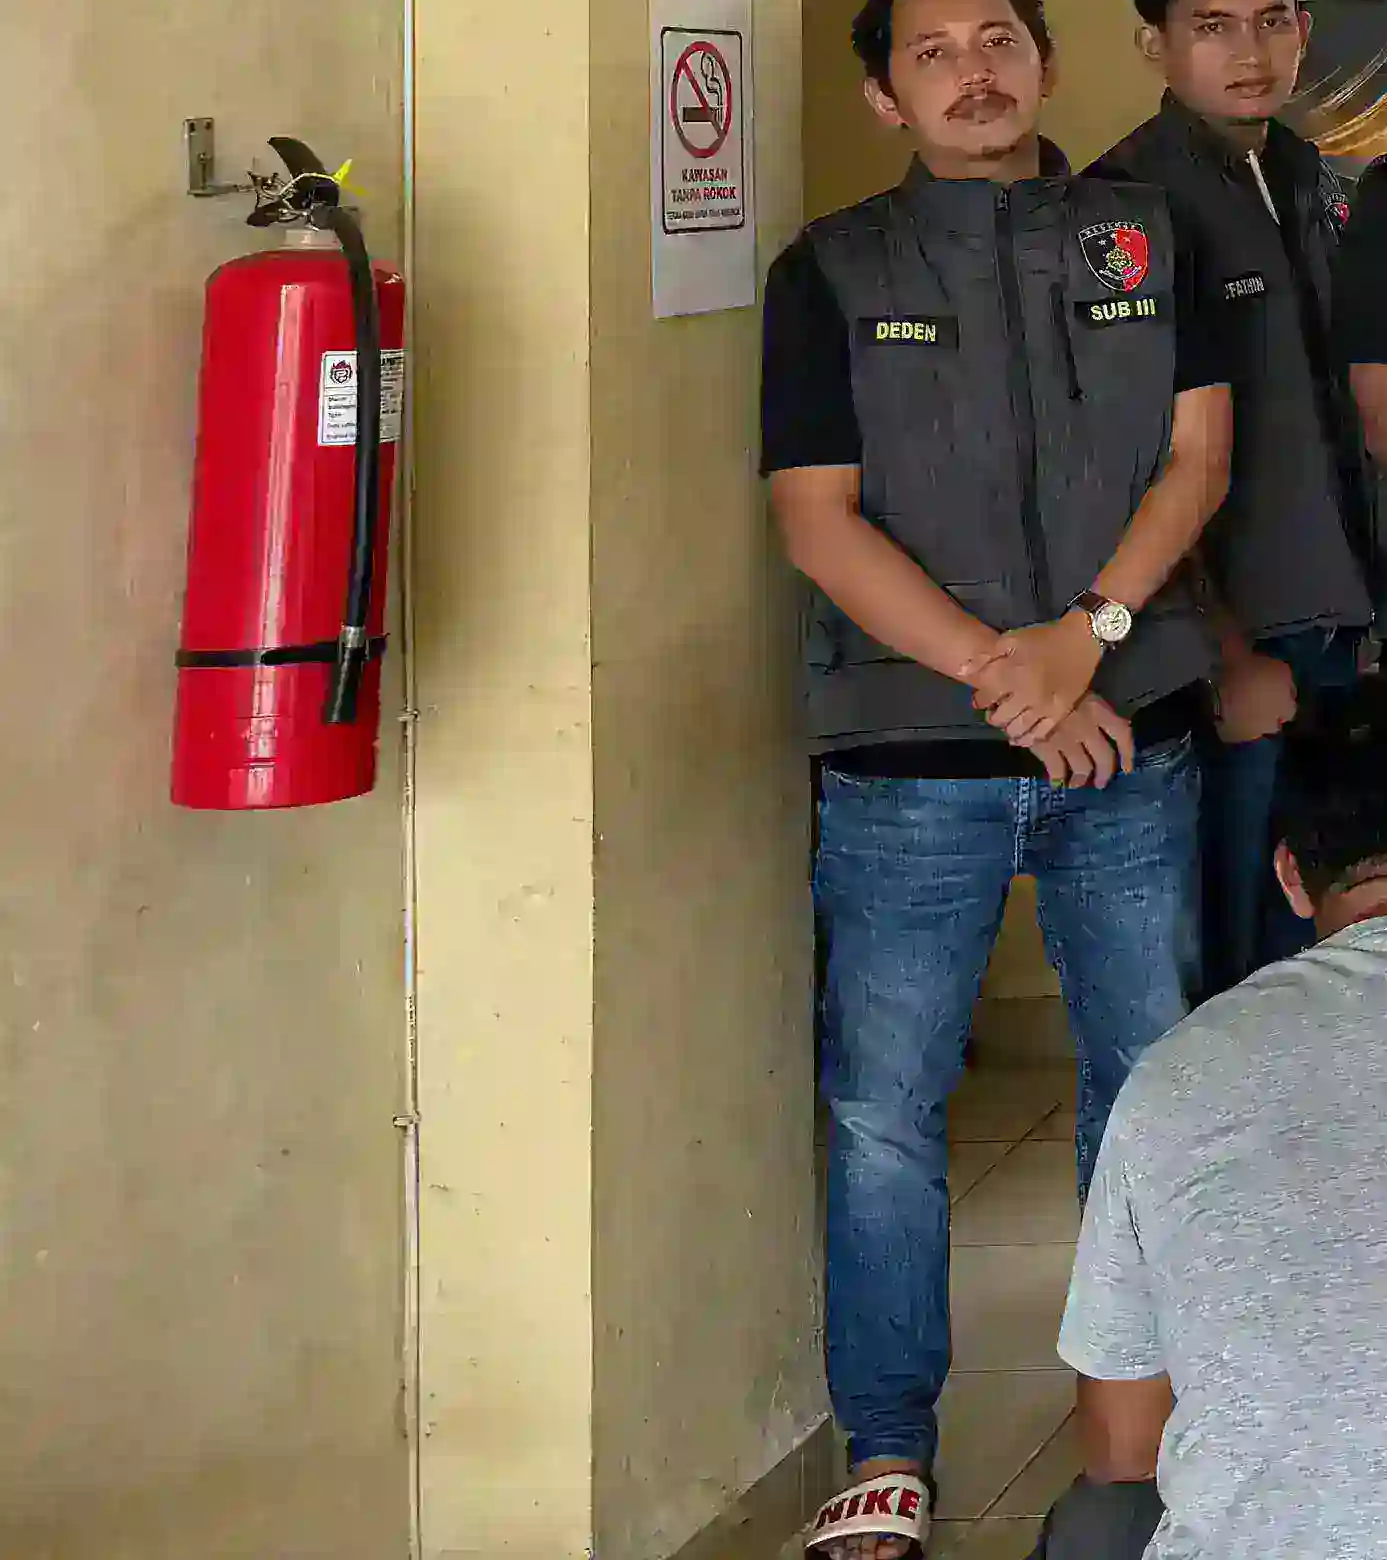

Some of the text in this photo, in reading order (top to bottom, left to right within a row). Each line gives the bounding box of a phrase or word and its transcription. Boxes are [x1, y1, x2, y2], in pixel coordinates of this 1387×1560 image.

[703, 186, 737, 200] ROKOK
[1090, 298, 1156, 322] SUB III
[876, 321, 937, 342] DEDEN
[813, 1485, 921, 1531] NIKE
